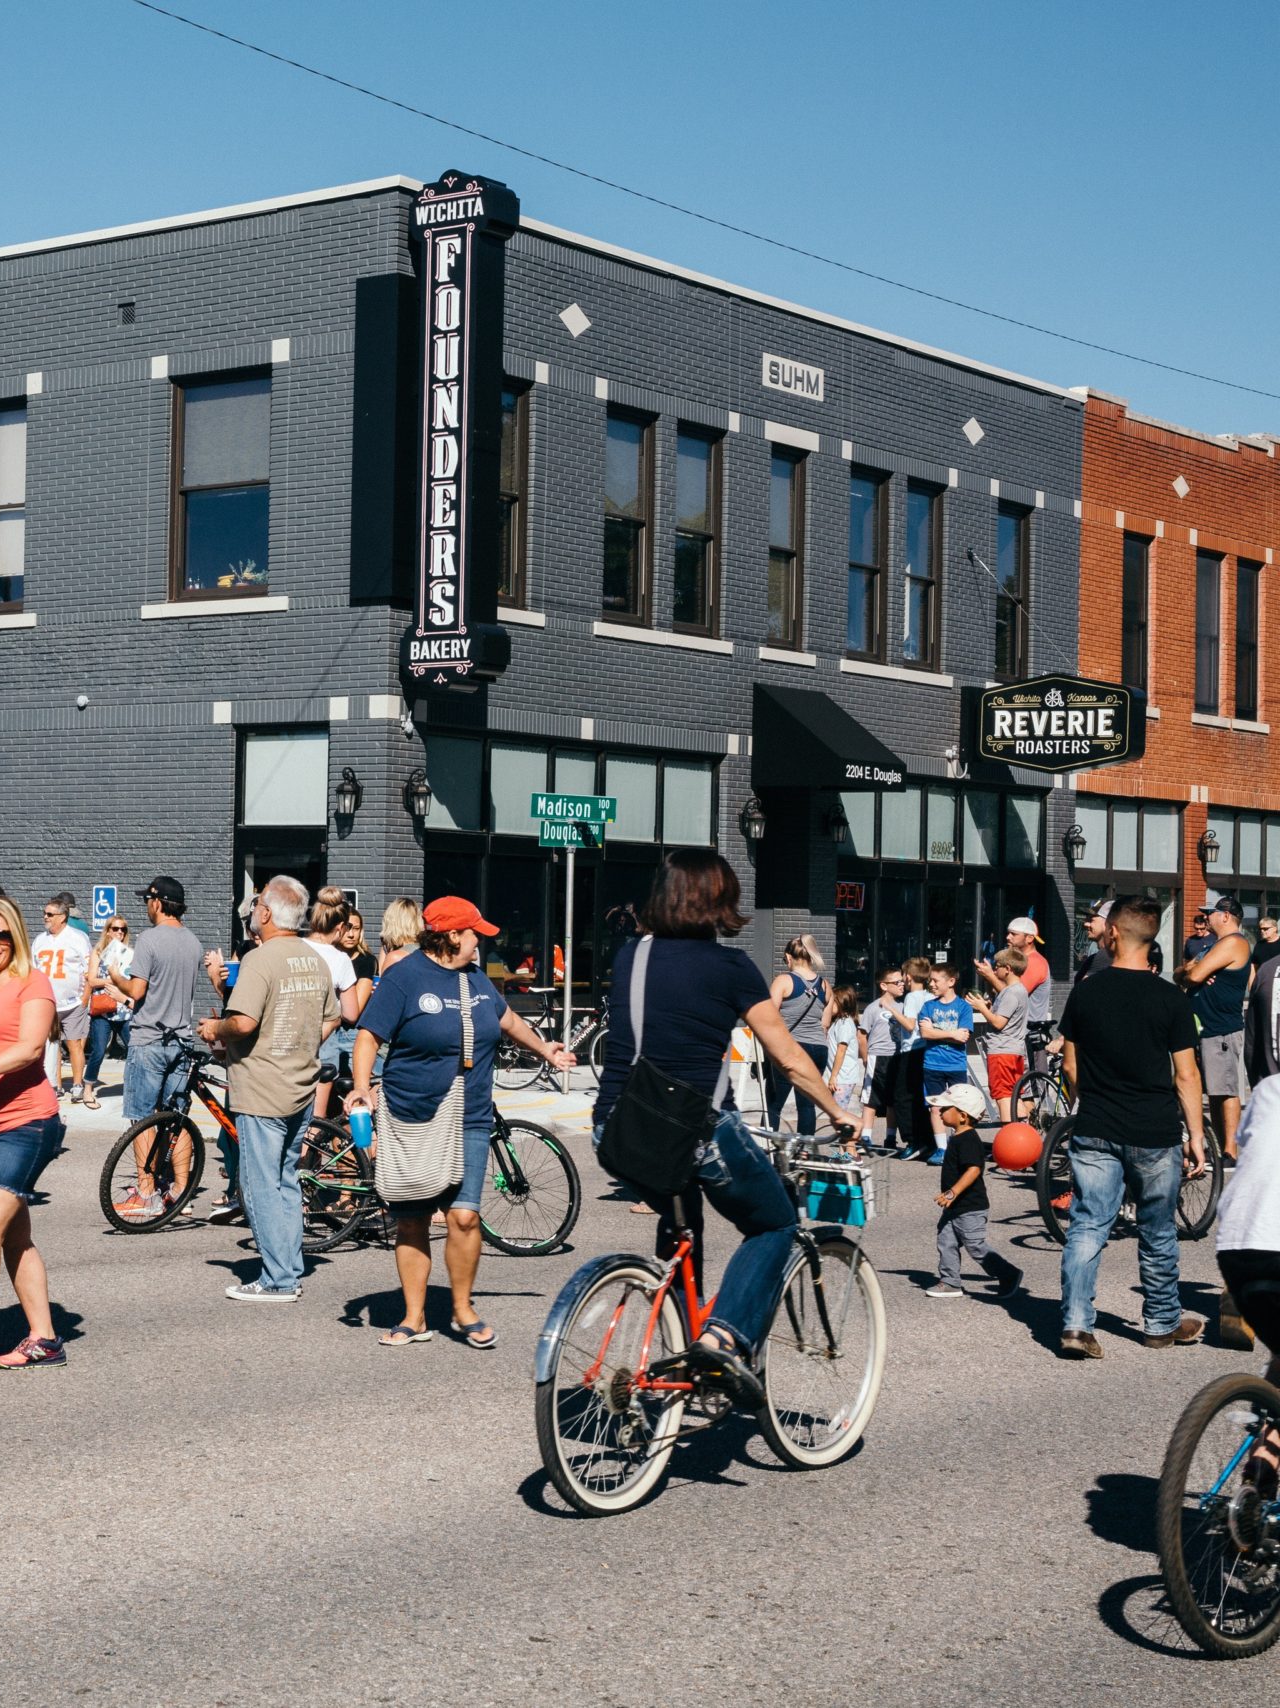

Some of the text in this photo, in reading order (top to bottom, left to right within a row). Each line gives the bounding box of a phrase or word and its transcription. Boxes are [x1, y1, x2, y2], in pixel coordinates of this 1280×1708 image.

[415, 196, 484, 226] WICHITA
[768, 360, 820, 396] SUHM
[429, 235, 462, 627] FOUNDERS
[410, 638, 472, 660] BAKERY
[1012, 692, 1098, 703] Wichita Kansas
[994, 708, 1116, 738] REVERIE
[1015, 740, 1091, 755] ROASTERS
[845, 764, 902, 785] 2204 E. Douglas
[537, 796, 610, 818] Madison 100
[543, 821, 582, 845] Douglas
[835, 882, 863, 909] PEN
[38, 949, 65, 978] 31
[286, 956, 320, 973] TRACY
